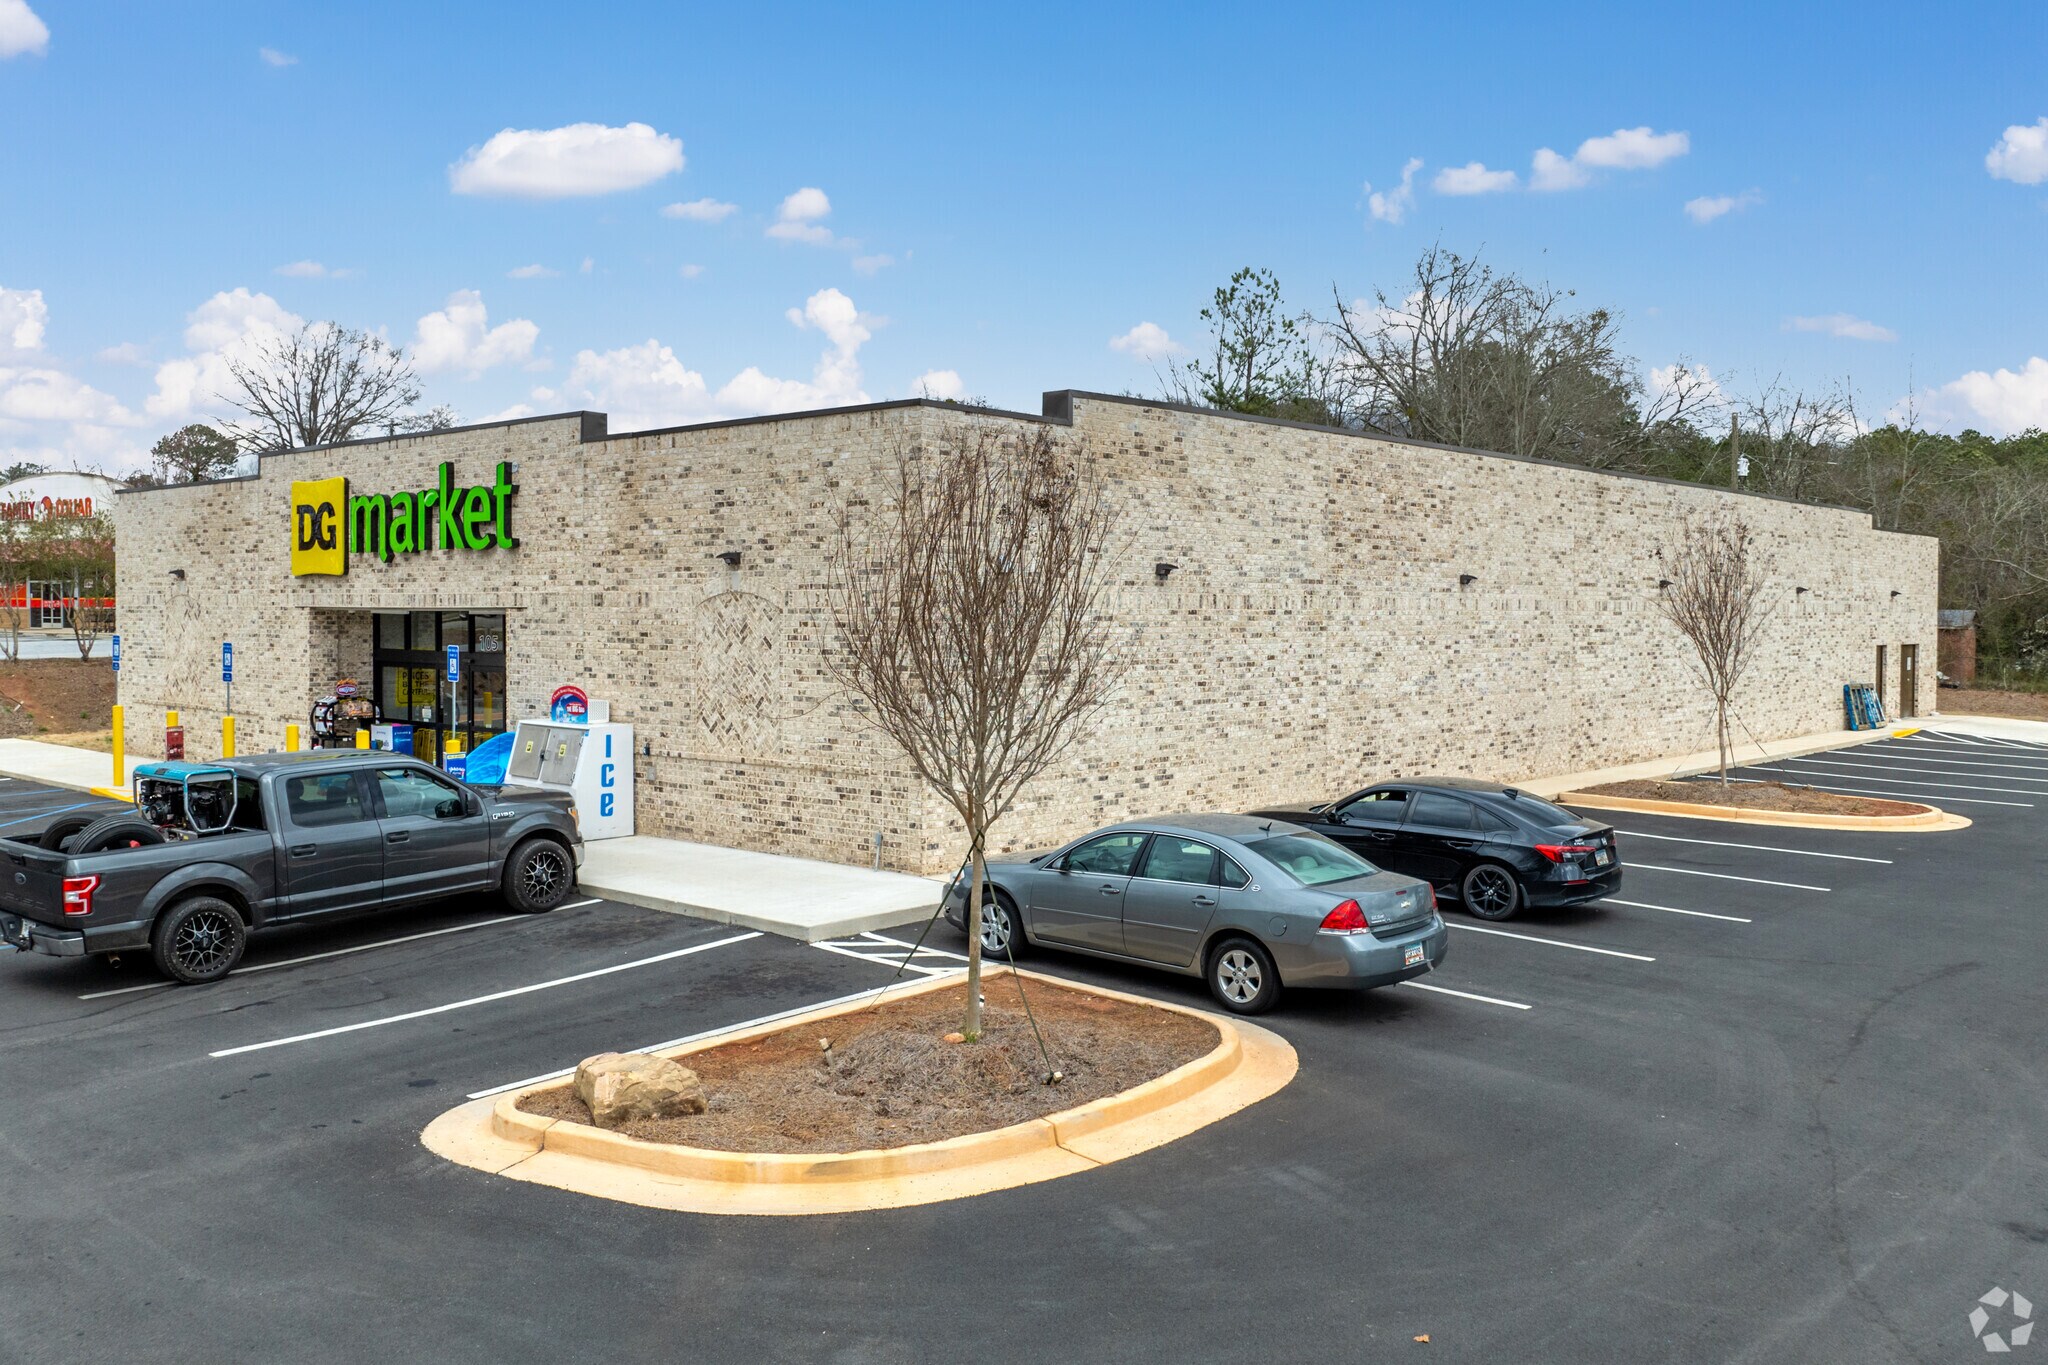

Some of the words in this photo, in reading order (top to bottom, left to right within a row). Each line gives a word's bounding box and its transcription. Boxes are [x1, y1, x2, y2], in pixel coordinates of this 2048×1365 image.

[296, 501, 337, 551] DG
[350, 461, 520, 563] market
[479, 634, 499, 652] 105
[402, 671, 429, 680] PICES
